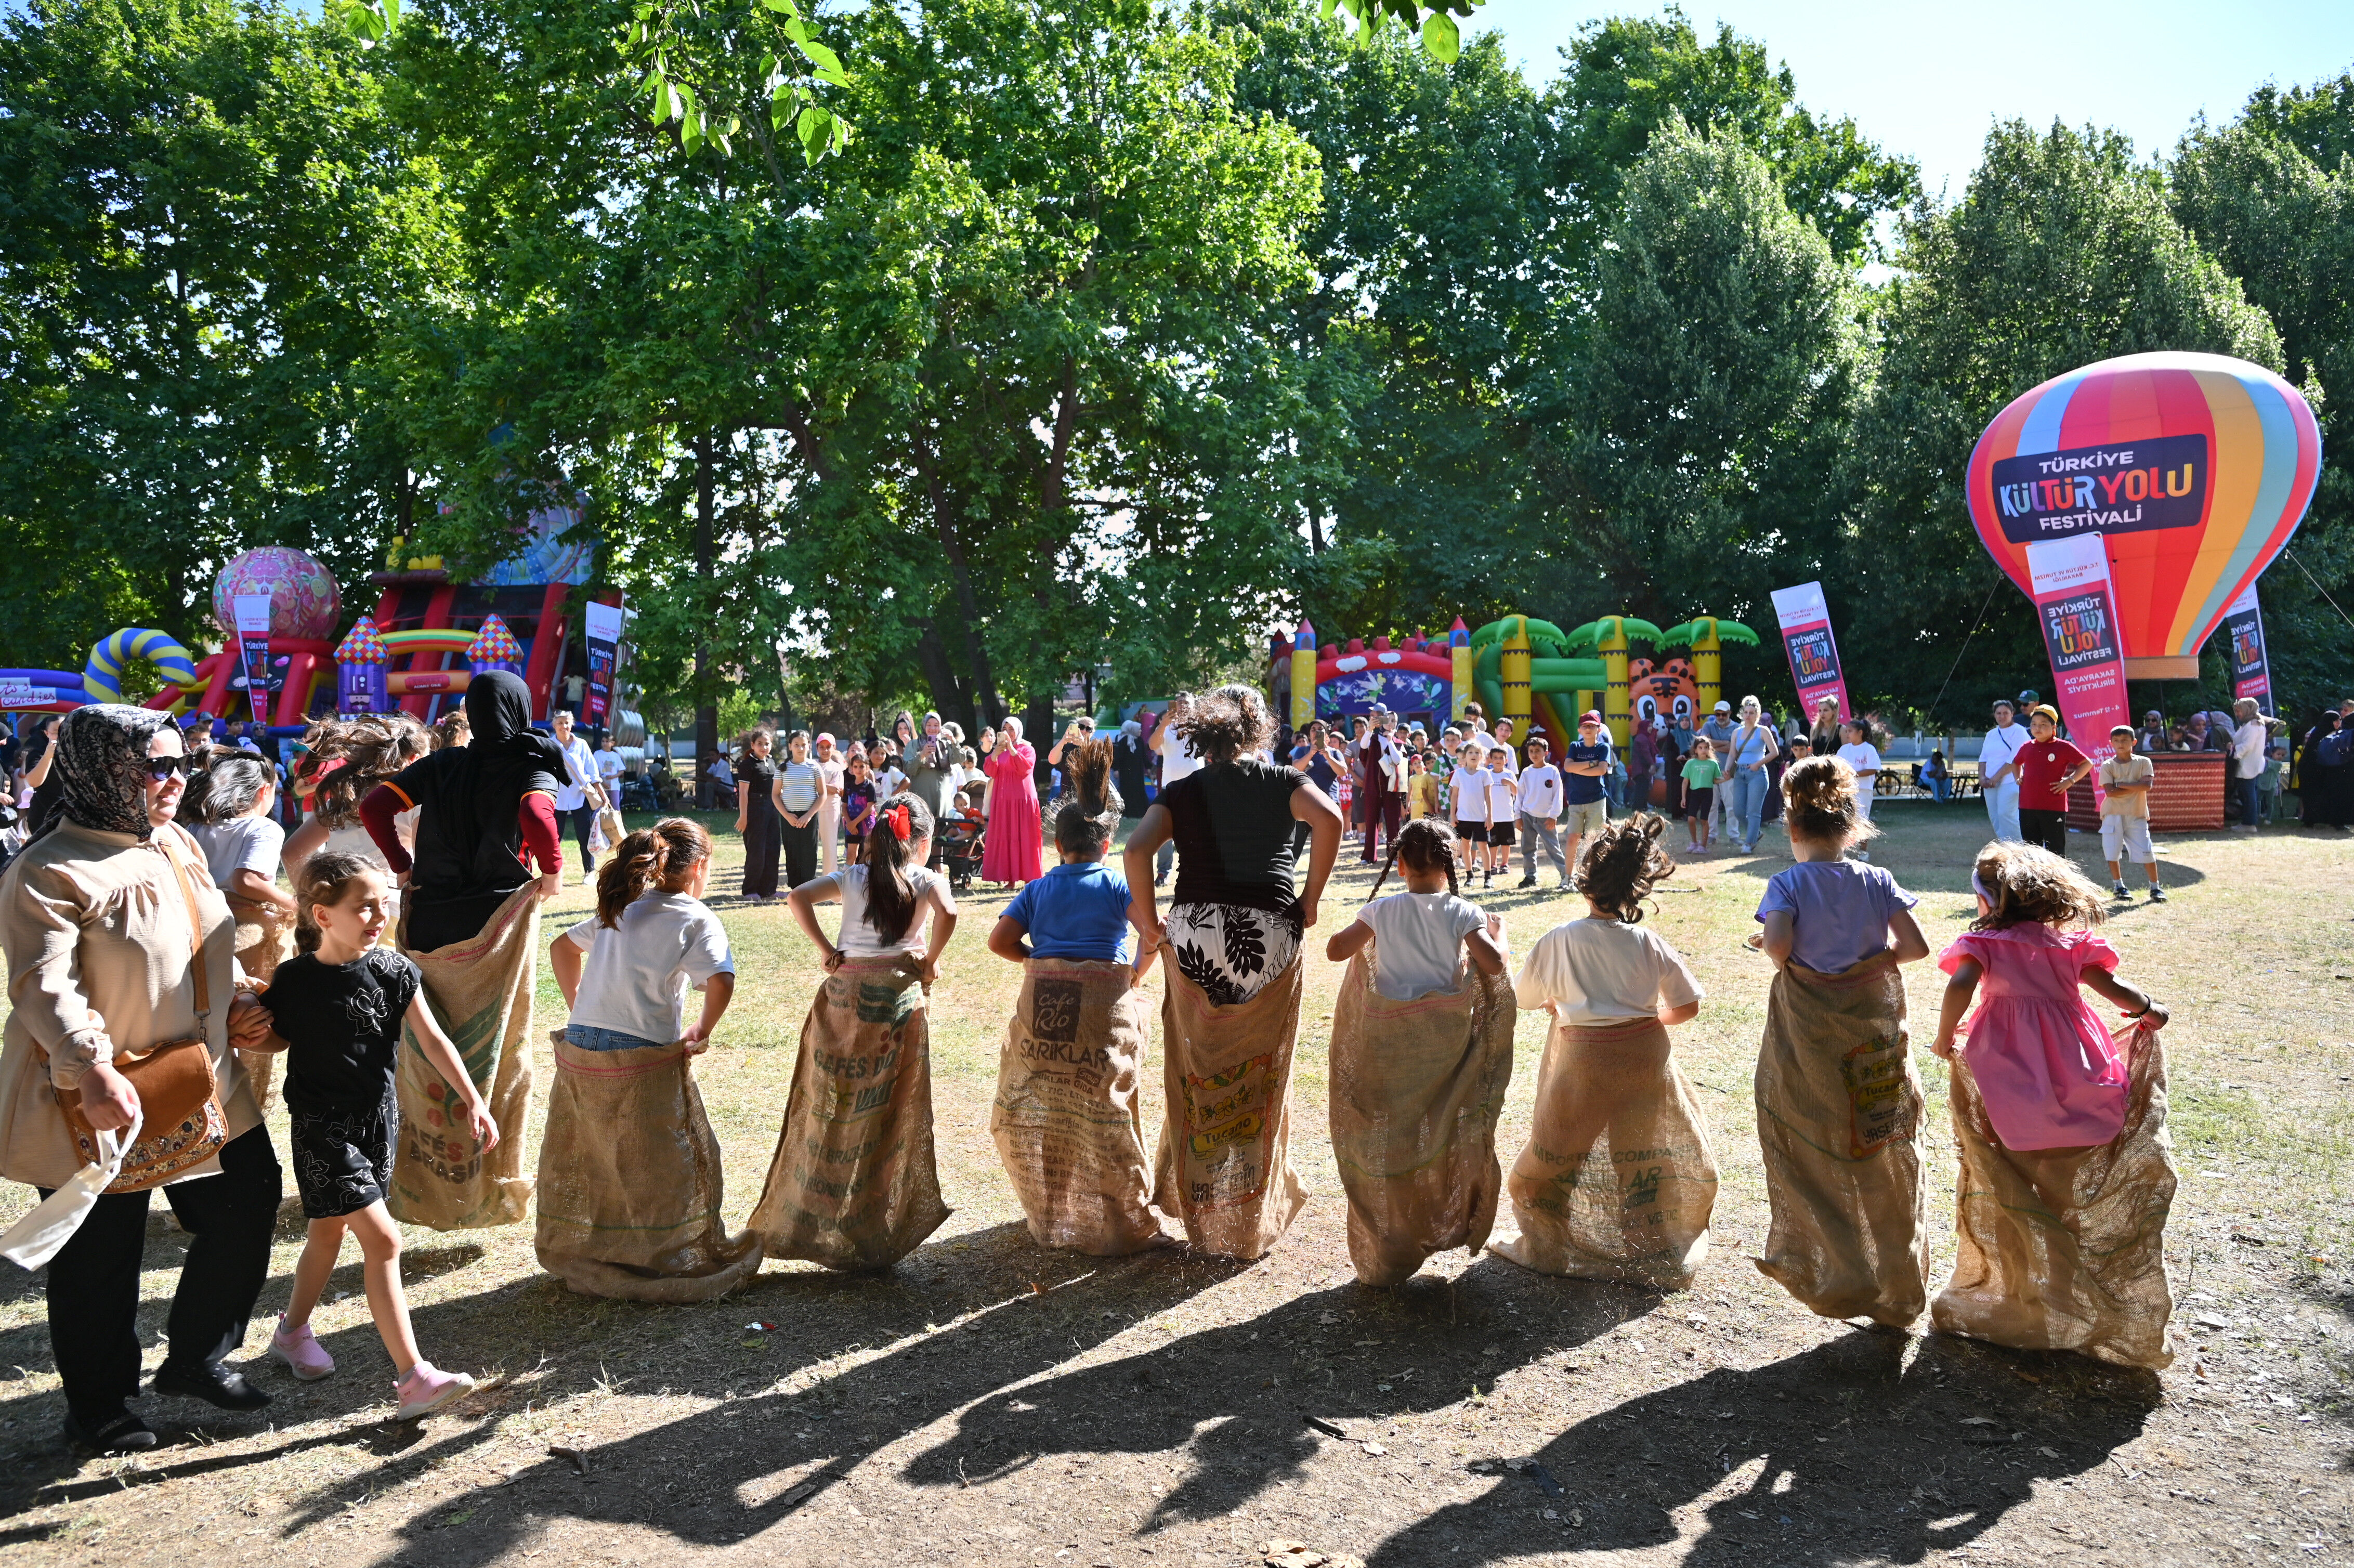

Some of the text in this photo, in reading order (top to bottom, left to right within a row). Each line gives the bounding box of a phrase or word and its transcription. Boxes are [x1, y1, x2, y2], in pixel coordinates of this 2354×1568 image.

[2039, 451, 2134, 474] TÜRKİYE
[2000, 463, 2192, 518] KÜLTÜR YOLU
[2039, 504, 2141, 531] FESTİVALİ
[245, 641, 268, 650] TÜRKİYE
[591, 647, 613, 660] TÜRKİYE
[3, 691, 56, 705] candies
[1035, 1008, 1070, 1031] Rio
[814, 1049, 896, 1079] CAFÉS DO
[1019, 1039, 1109, 1072] SARIKLAR
[1078, 1068, 1101, 1084] Group
[1202, 1117, 1251, 1144] Tucano
